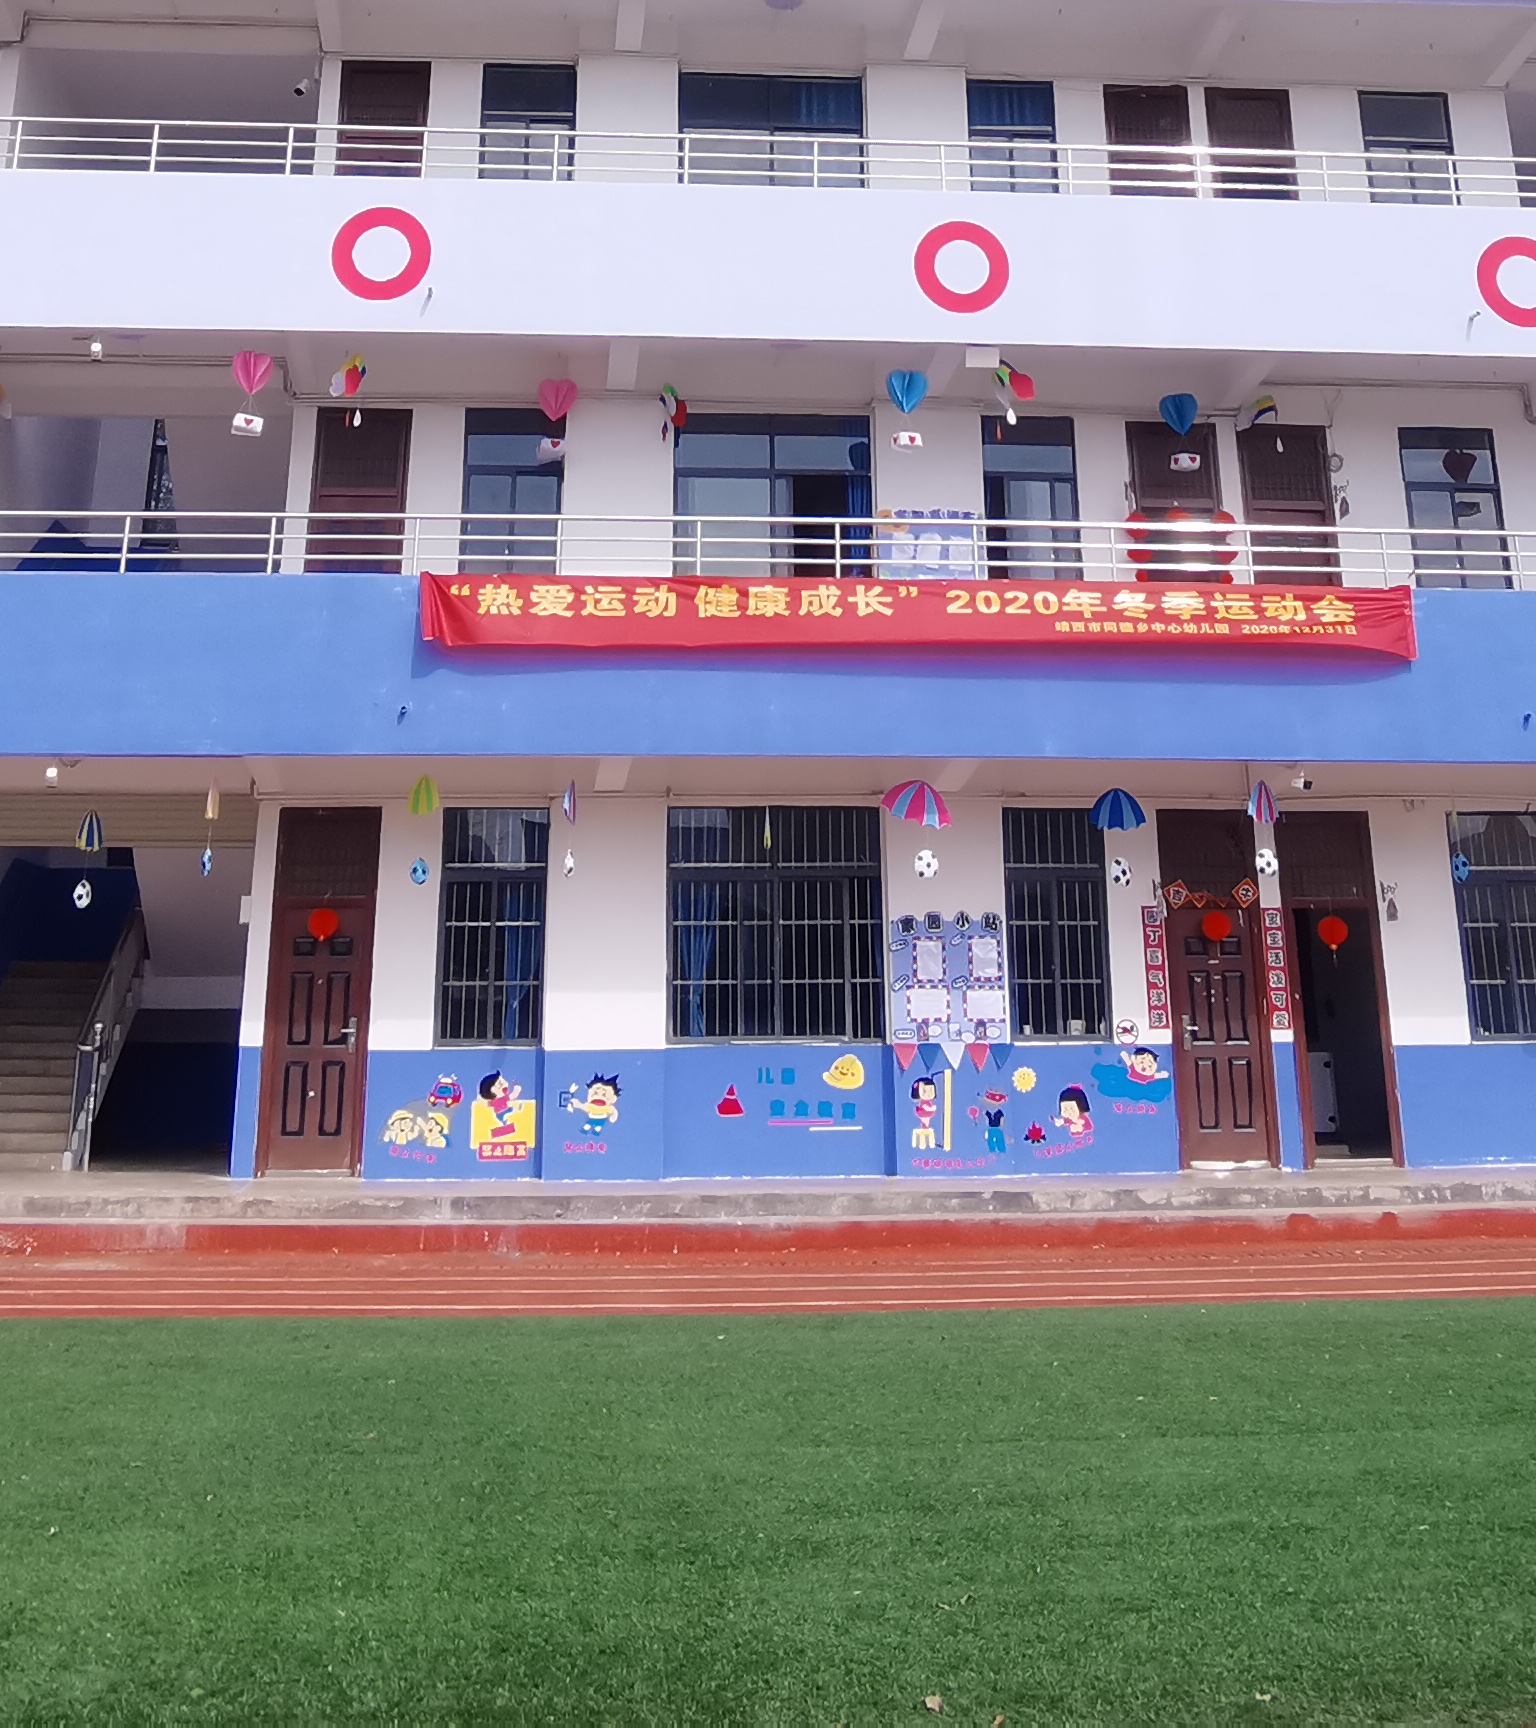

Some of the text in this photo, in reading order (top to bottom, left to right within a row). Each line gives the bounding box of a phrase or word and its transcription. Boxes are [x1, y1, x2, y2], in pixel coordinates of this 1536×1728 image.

[945, 589, 1357, 623] 2020年冬季运动会
